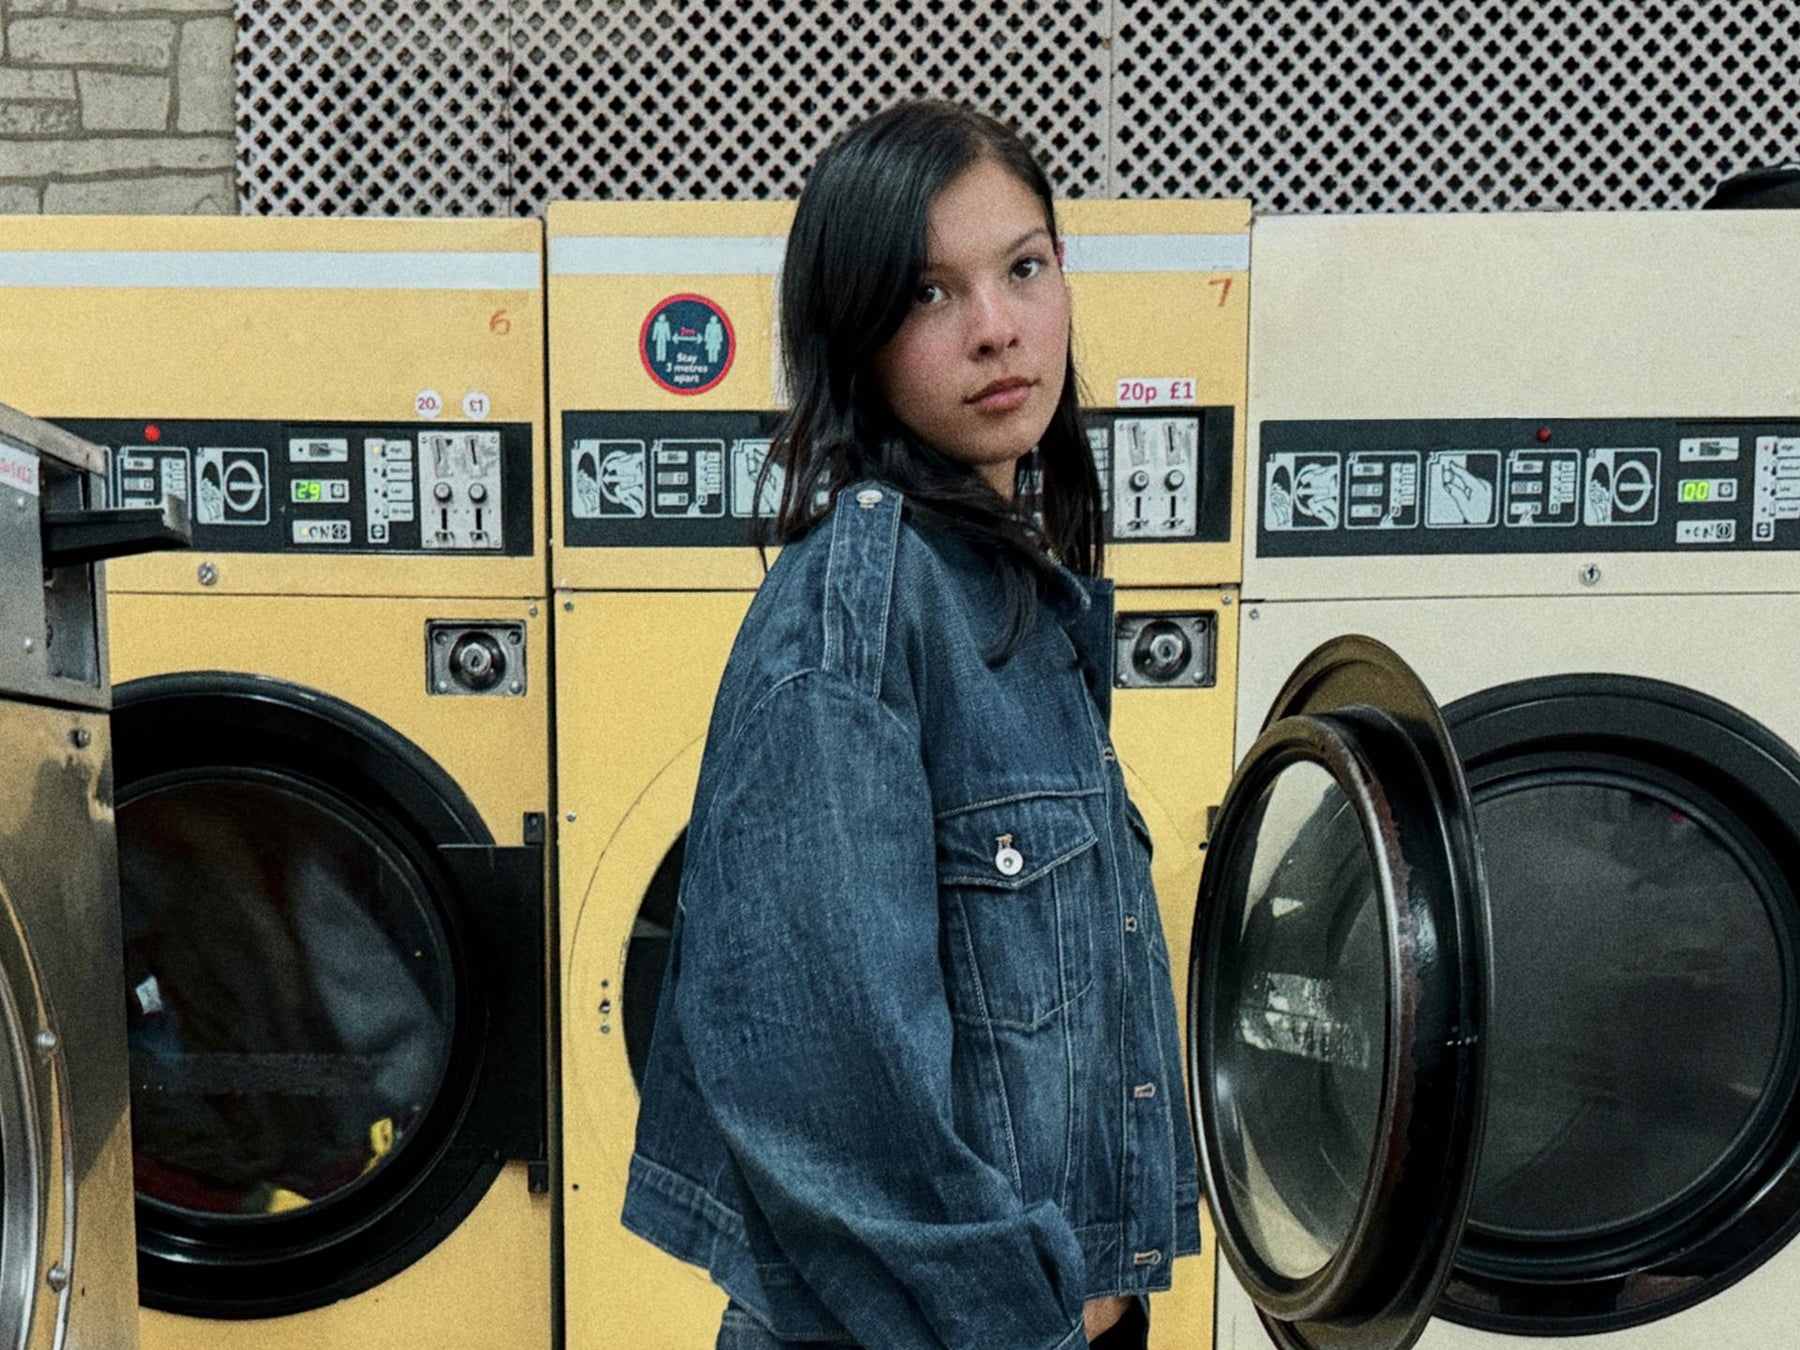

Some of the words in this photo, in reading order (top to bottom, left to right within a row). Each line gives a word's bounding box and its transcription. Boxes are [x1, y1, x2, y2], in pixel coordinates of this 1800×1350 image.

[1209, 277, 1233, 307] 7
[489, 309, 511, 336] 6
[676, 352, 698, 364] Stay
[673, 364, 708, 374] metres
[673, 374, 700, 385] apart
[1119, 381, 1158, 404] 20p
[1169, 381, 1194, 400] £1
[296, 481, 321, 500] 29
